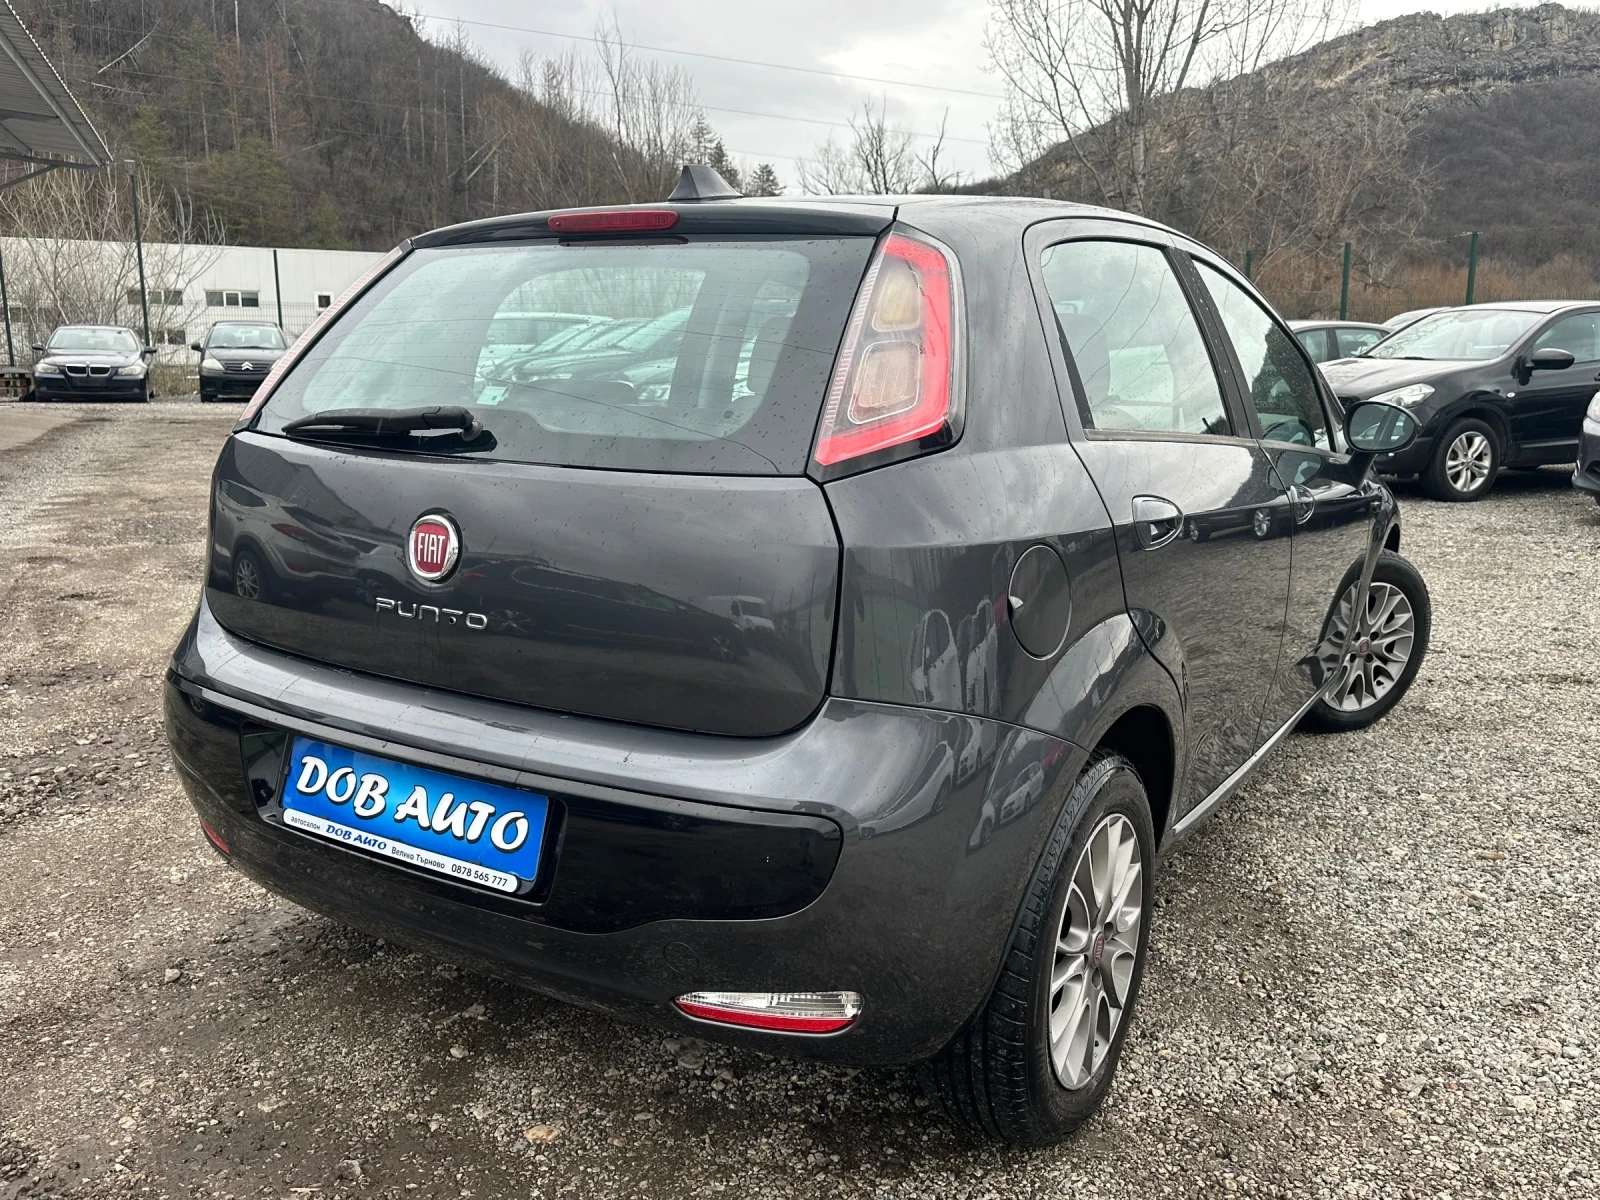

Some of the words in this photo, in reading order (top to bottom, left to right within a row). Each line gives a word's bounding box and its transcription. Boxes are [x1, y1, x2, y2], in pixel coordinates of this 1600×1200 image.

[417, 532, 446, 564] FIAT
[375, 597, 488, 630] PUNTO
[296, 755, 389, 818] DOB
[393, 785, 530, 852] AUTO
[290, 816, 321, 830] автосалон
[326, 824, 353, 840] DOB
[353, 834, 387, 850] AUTO
[391, 846, 415, 860] Велико
[416, 853, 446, 869] Търново
[451, 863, 472, 877] 0878
[473, 870, 490, 882] 565
[491, 875, 508, 887] 777
